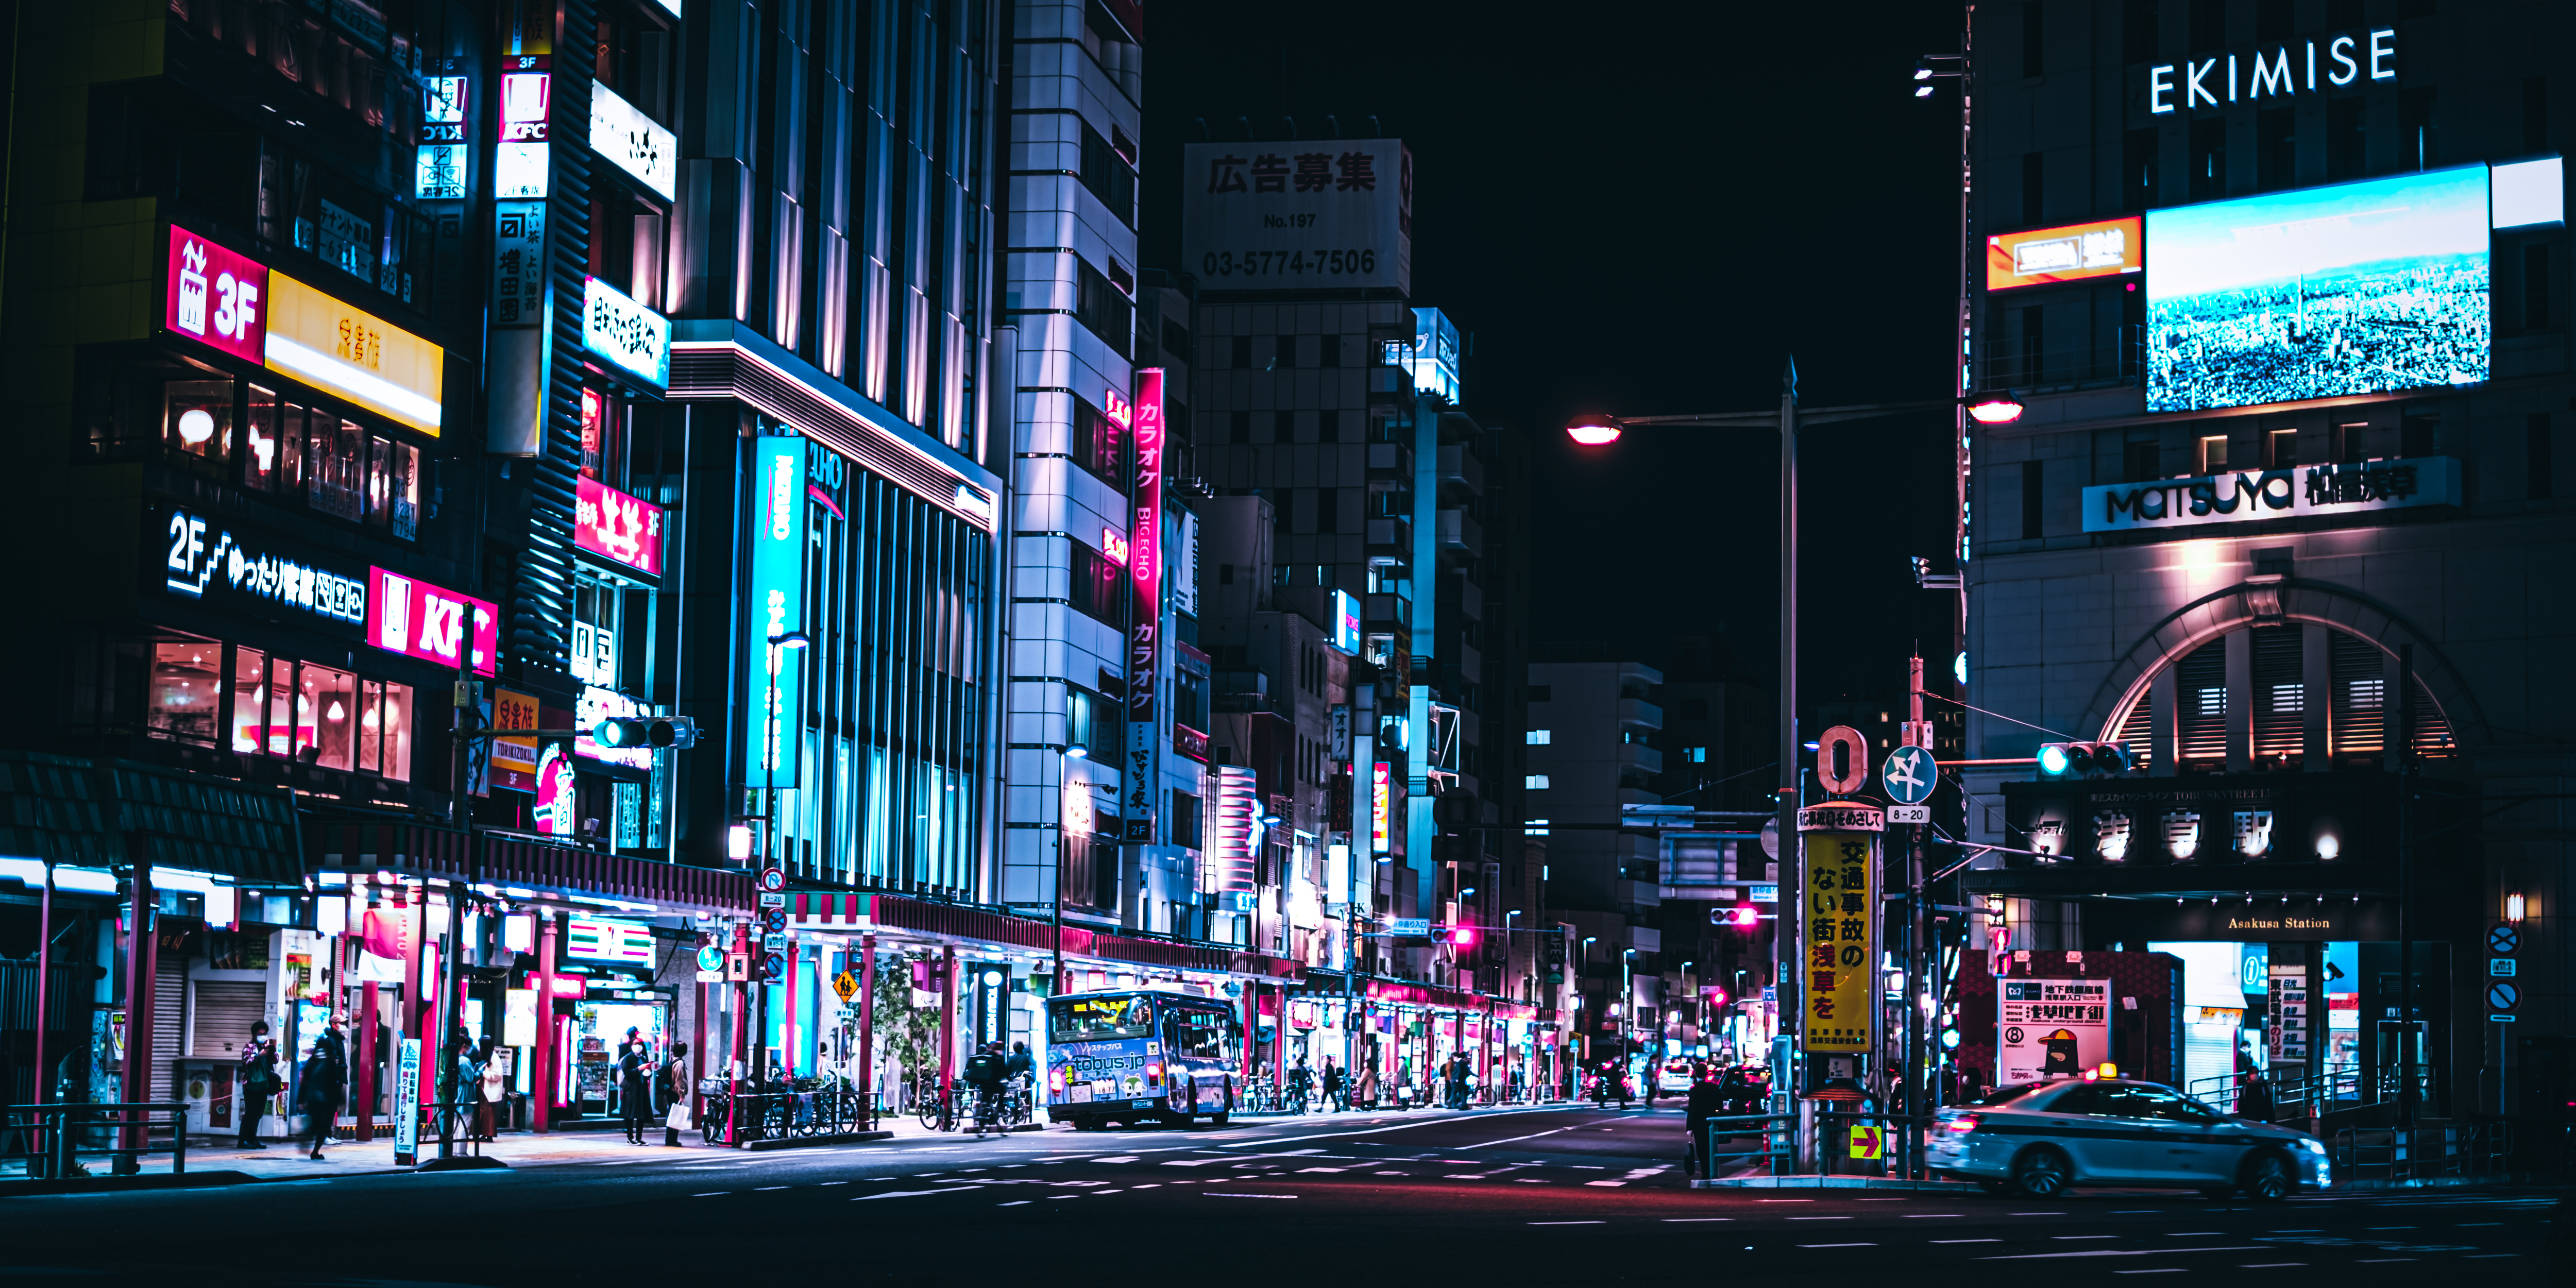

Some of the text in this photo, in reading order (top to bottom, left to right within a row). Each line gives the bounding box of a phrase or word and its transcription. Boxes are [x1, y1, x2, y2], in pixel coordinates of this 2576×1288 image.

[519, 57, 536, 69] 3F
[2150, 29, 2396, 114] EKIMISE
[503, 122, 547, 140] KFC
[1207, 151, 1376, 194] 広告募集
[1264, 214, 1316, 228] No.197
[524, 205, 539, 311] よい茶・よい海苔
[1204, 249, 1375, 276] 03-5774-7506
[499, 249, 520, 322] 増田園
[214, 272, 258, 341] 3F
[1137, 403, 1159, 488] カラオケ
[647, 510, 659, 537] 3F
[168, 514, 206, 573] 2F
[1136, 507, 1151, 581] BIG ECHO
[228, 547, 315, 609] ゆったり客席
[1130, 623, 1154, 709] カラオケ
[497, 742, 532, 761] TORIKIZOKU
[510, 772, 518, 785] 3F
[2091, 791, 2168, 803] 東武スカイツリーライン
[2175, 791, 2204, 801] TOBU
[2207, 789, 2258, 801] SKYTREE
[1131, 825, 1146, 836] 2F
[1893, 809, 1923, 820] 8-20
[1840, 841, 1865, 967] 交通事故の
[2229, 918, 2330, 928] Asakusa Station
[1811, 867, 1836, 1020] ない街浅草を
[2045, 985, 2104, 994] 地下鉄銀座線
[2270, 979, 2282, 1056] 東武電車のりば
[1073, 1052, 1146, 1072] tobus.jp
[408, 1072, 416, 1104] 自転車は
[398, 1071, 409, 1144] 降りて通行しましょう
